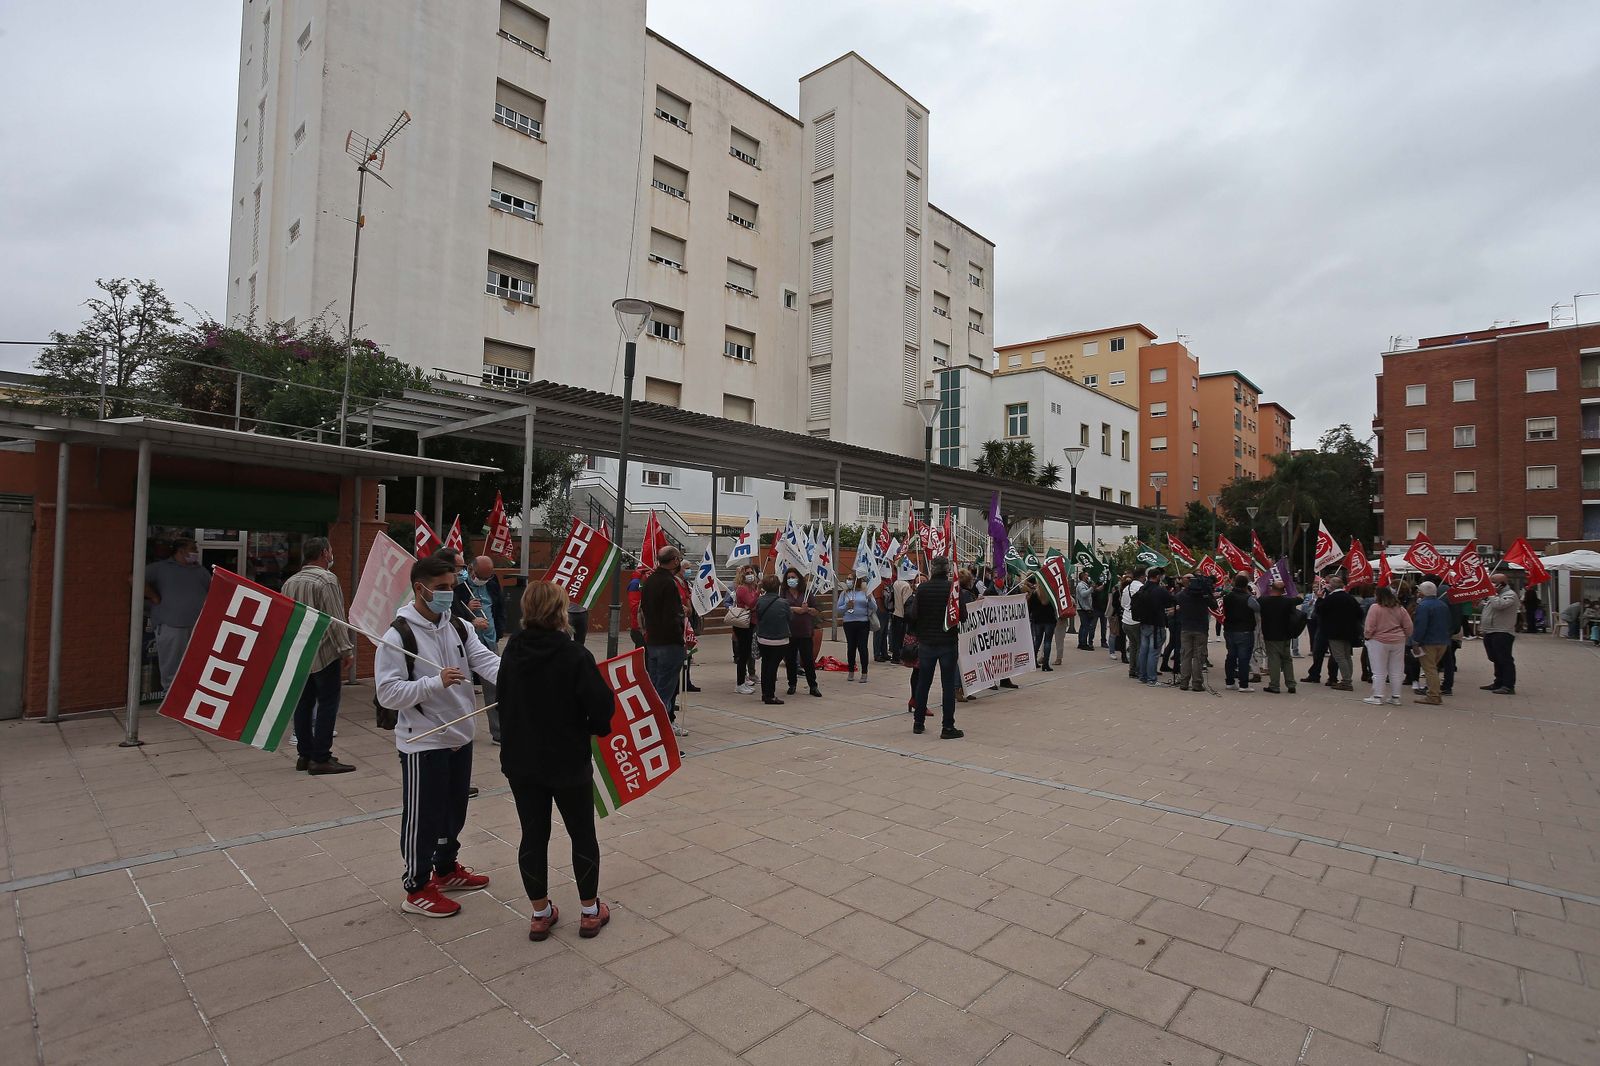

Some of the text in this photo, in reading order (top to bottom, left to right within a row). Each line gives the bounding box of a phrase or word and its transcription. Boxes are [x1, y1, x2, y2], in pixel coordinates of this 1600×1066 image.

[1414, 545, 1438, 569] UGT
[1453, 588, 1489, 598] www.ugt.es
[184, 584, 272, 730] CCOO
[608, 656, 670, 781] CCOO
[610, 734, 641, 793] Cádiz
